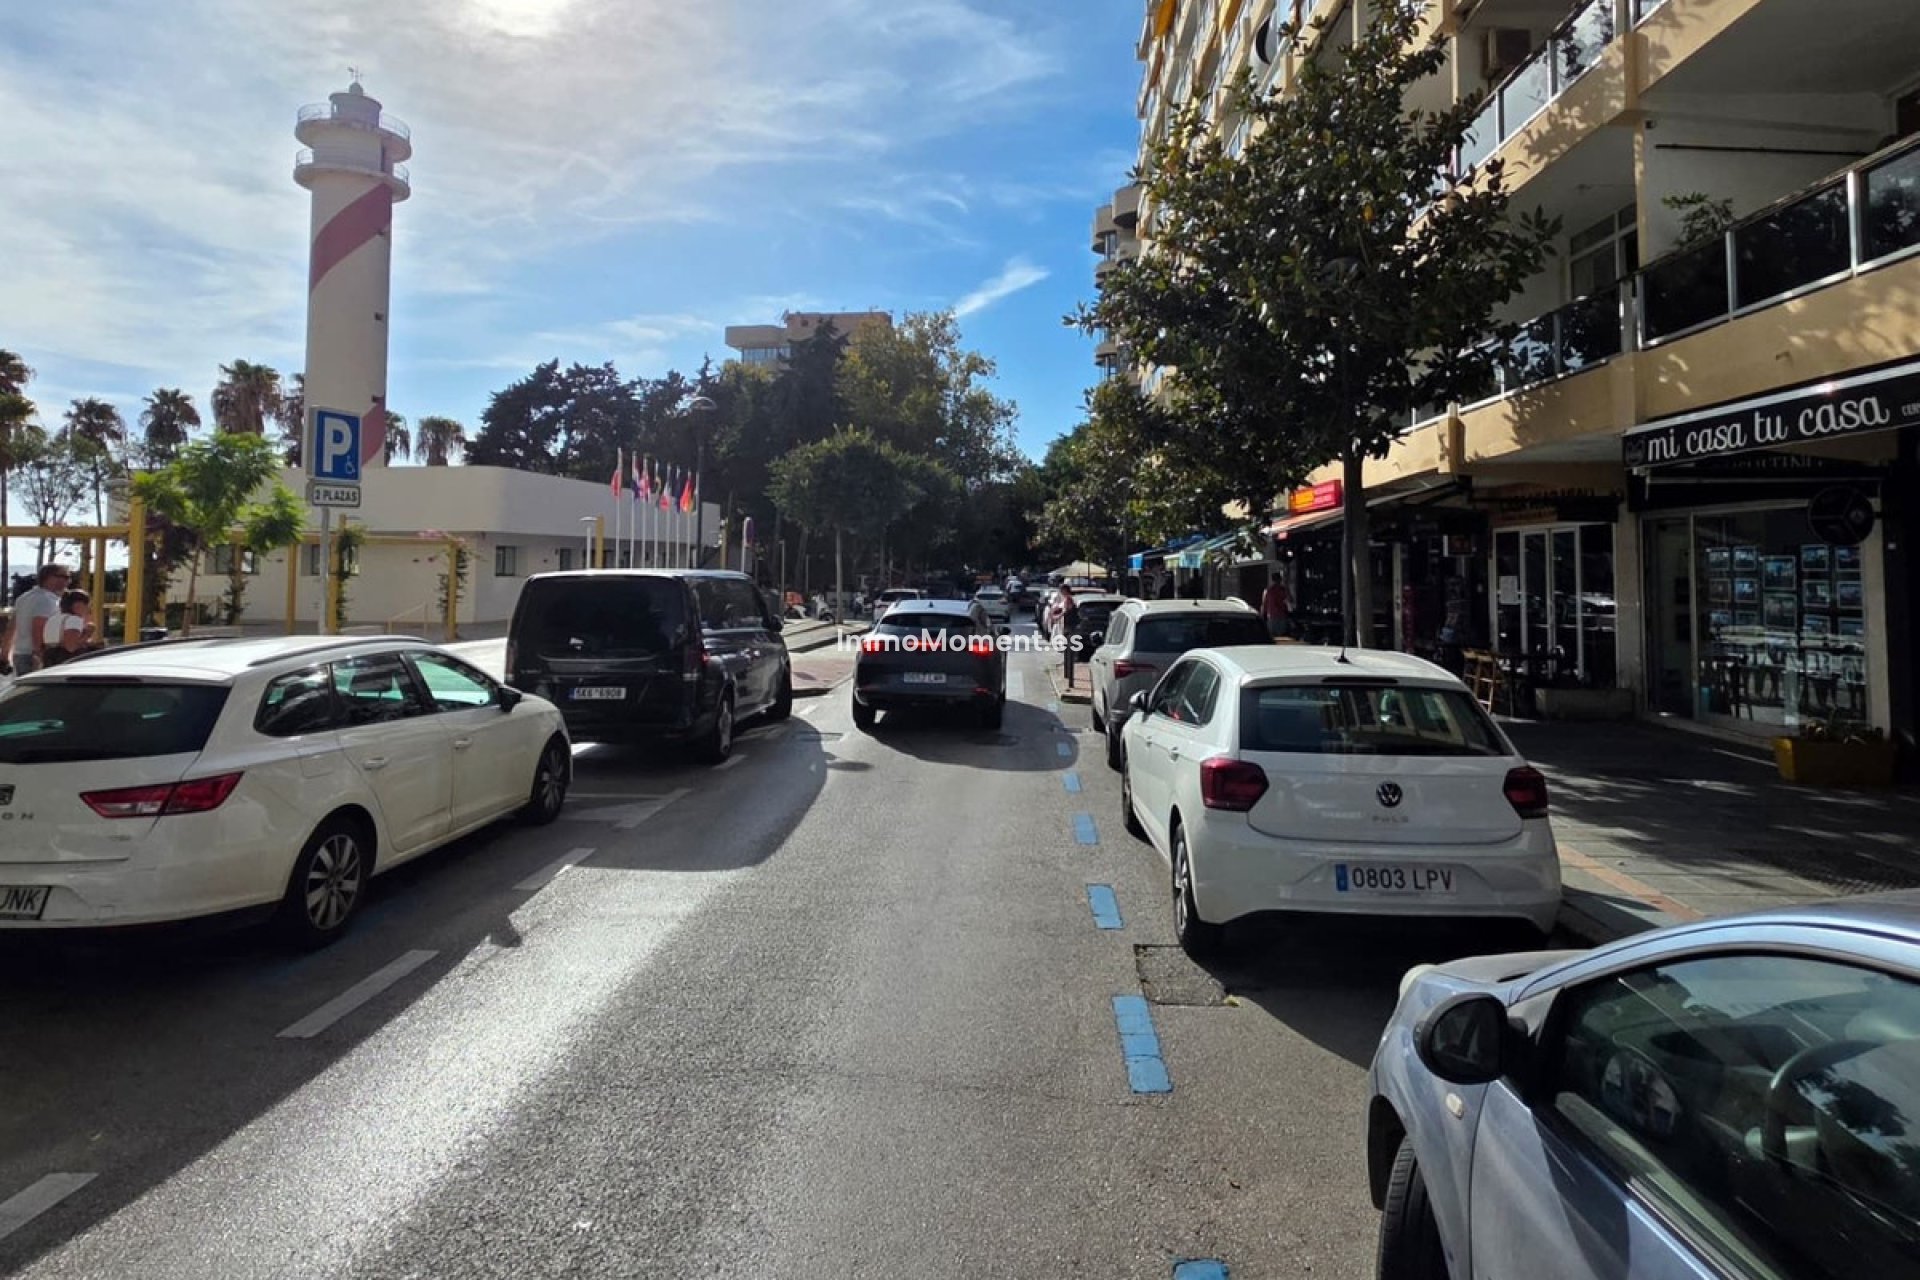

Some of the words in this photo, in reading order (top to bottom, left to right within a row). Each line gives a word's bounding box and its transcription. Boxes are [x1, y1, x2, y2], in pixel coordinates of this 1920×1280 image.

[323, 417, 352, 473] P
[1647, 428, 1680, 461] mi
[1686, 423, 1747, 454] casa
[1754, 410, 1788, 442] tu
[1799, 397, 1890, 436] casa
[323, 489, 358, 502] PLAZAS
[1352, 867, 1406, 889] 0803
[1413, 868, 1452, 890] LPV
